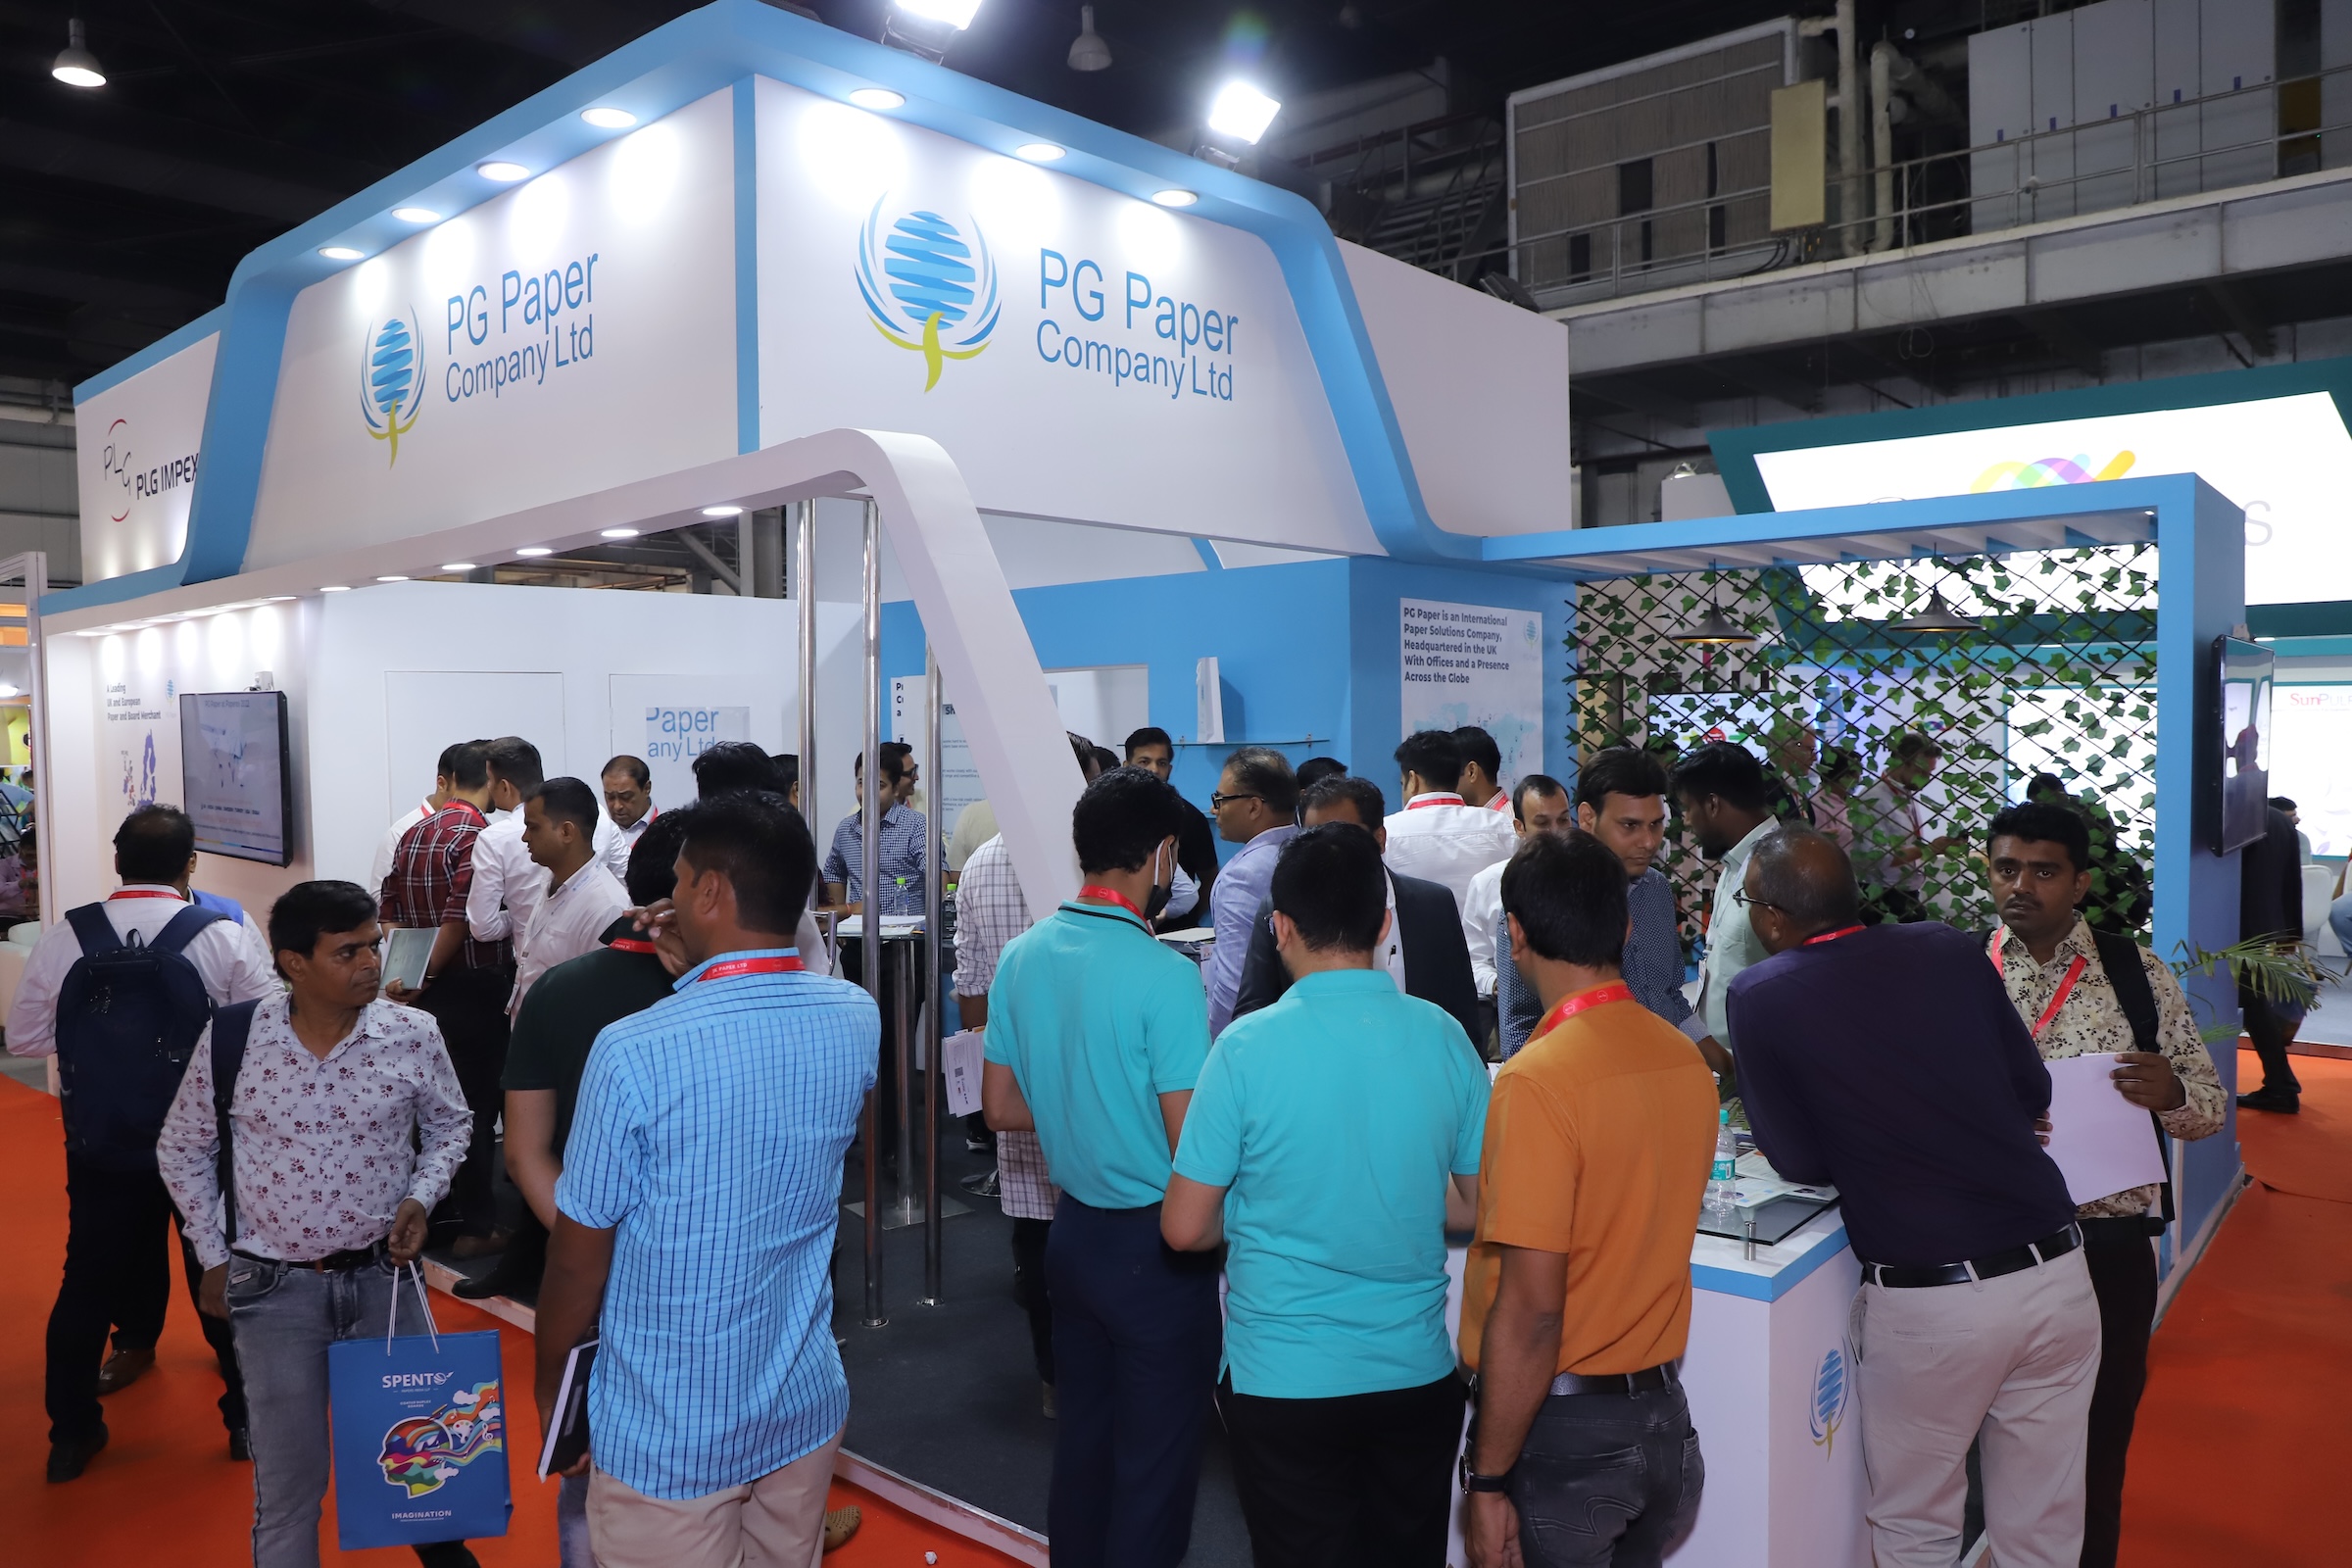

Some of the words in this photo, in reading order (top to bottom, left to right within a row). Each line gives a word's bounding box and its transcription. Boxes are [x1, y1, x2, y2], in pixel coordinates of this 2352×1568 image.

[447, 285, 488, 356] PG
[502, 253, 599, 335] Paper
[1040, 247, 1104, 321] PG
[1126, 270, 1239, 359] Paper
[446, 339, 550, 403] Company
[555, 313, 593, 368] Ltd
[1037, 319, 1186, 400] Company
[1193, 355, 1233, 402] Ltd
[136, 468, 159, 501] PLG
[161, 453, 199, 492] IMPEX
[1403, 608, 1415, 618] PG
[1417, 609, 1441, 622] Paper
[1442, 610, 1448, 621] is
[1450, 612, 1460, 622] an
[1461, 612, 1507, 626] International
[1404, 623, 1428, 637] Paper
[1430, 625, 1465, 638] Solutions
[1466, 628, 1502, 643] Company,
[1404, 639, 1463, 653] Headquartered
[1464, 642, 1472, 654] in
[1473, 644, 1486, 655] the
[1487, 645, 1497, 656] UK
[1404, 655, 1425, 666] With
[1426, 656, 1454, 668] Offices
[1455, 659, 1470, 668] and
[1477, 660, 1509, 670] Presence
[1404, 671, 1432, 682] Across
[1433, 672, 1446, 683] the
[1448, 672, 1470, 684] Globe
[392, 1510, 452, 1519] IMAGINATION
